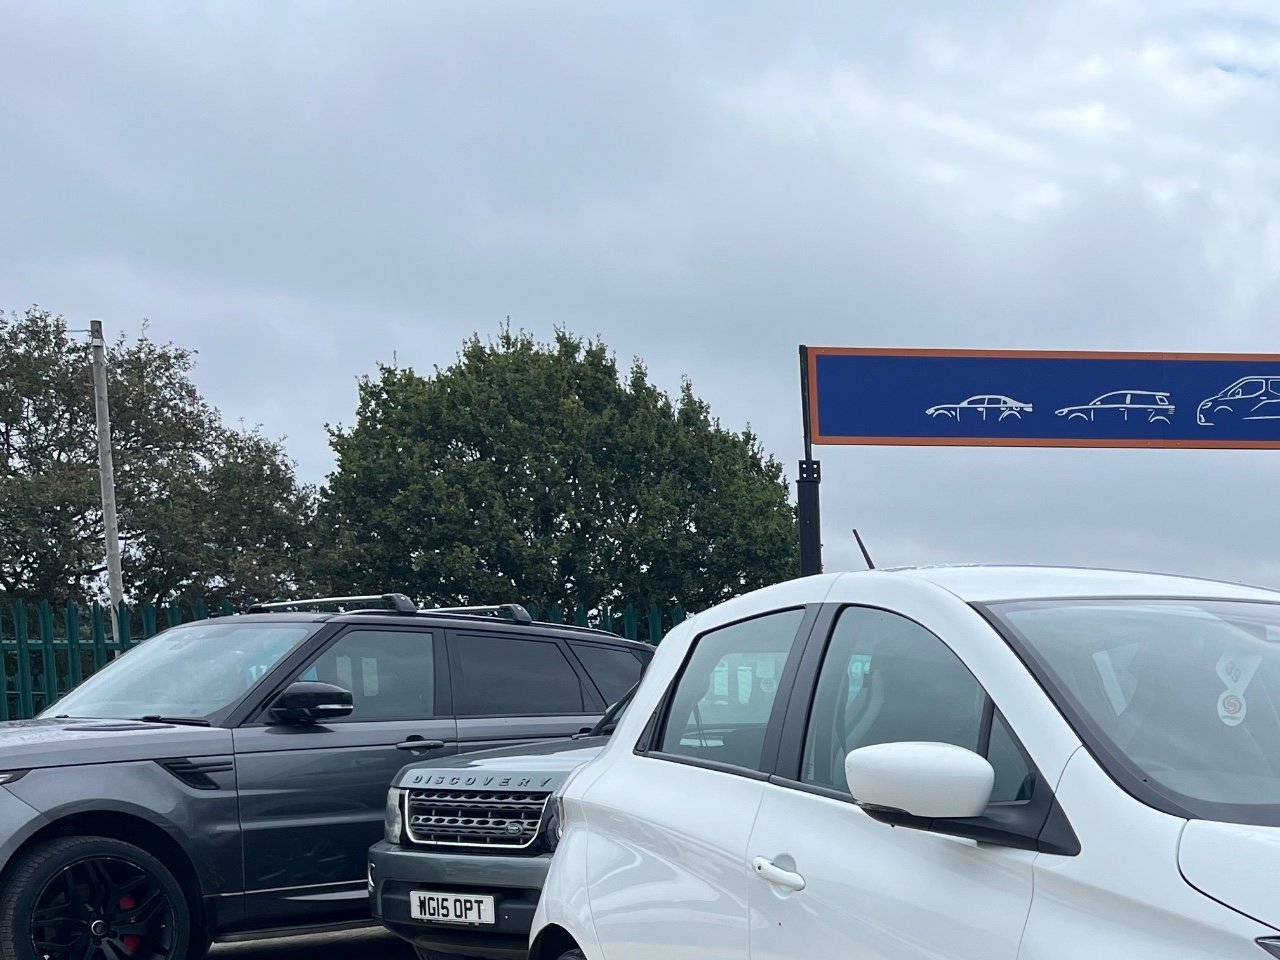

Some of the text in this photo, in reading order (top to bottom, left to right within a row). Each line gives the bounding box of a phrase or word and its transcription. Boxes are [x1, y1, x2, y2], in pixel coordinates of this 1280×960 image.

[412, 775, 552, 788] DISCOVERY
[418, 895, 484, 920] WG15 OPT
